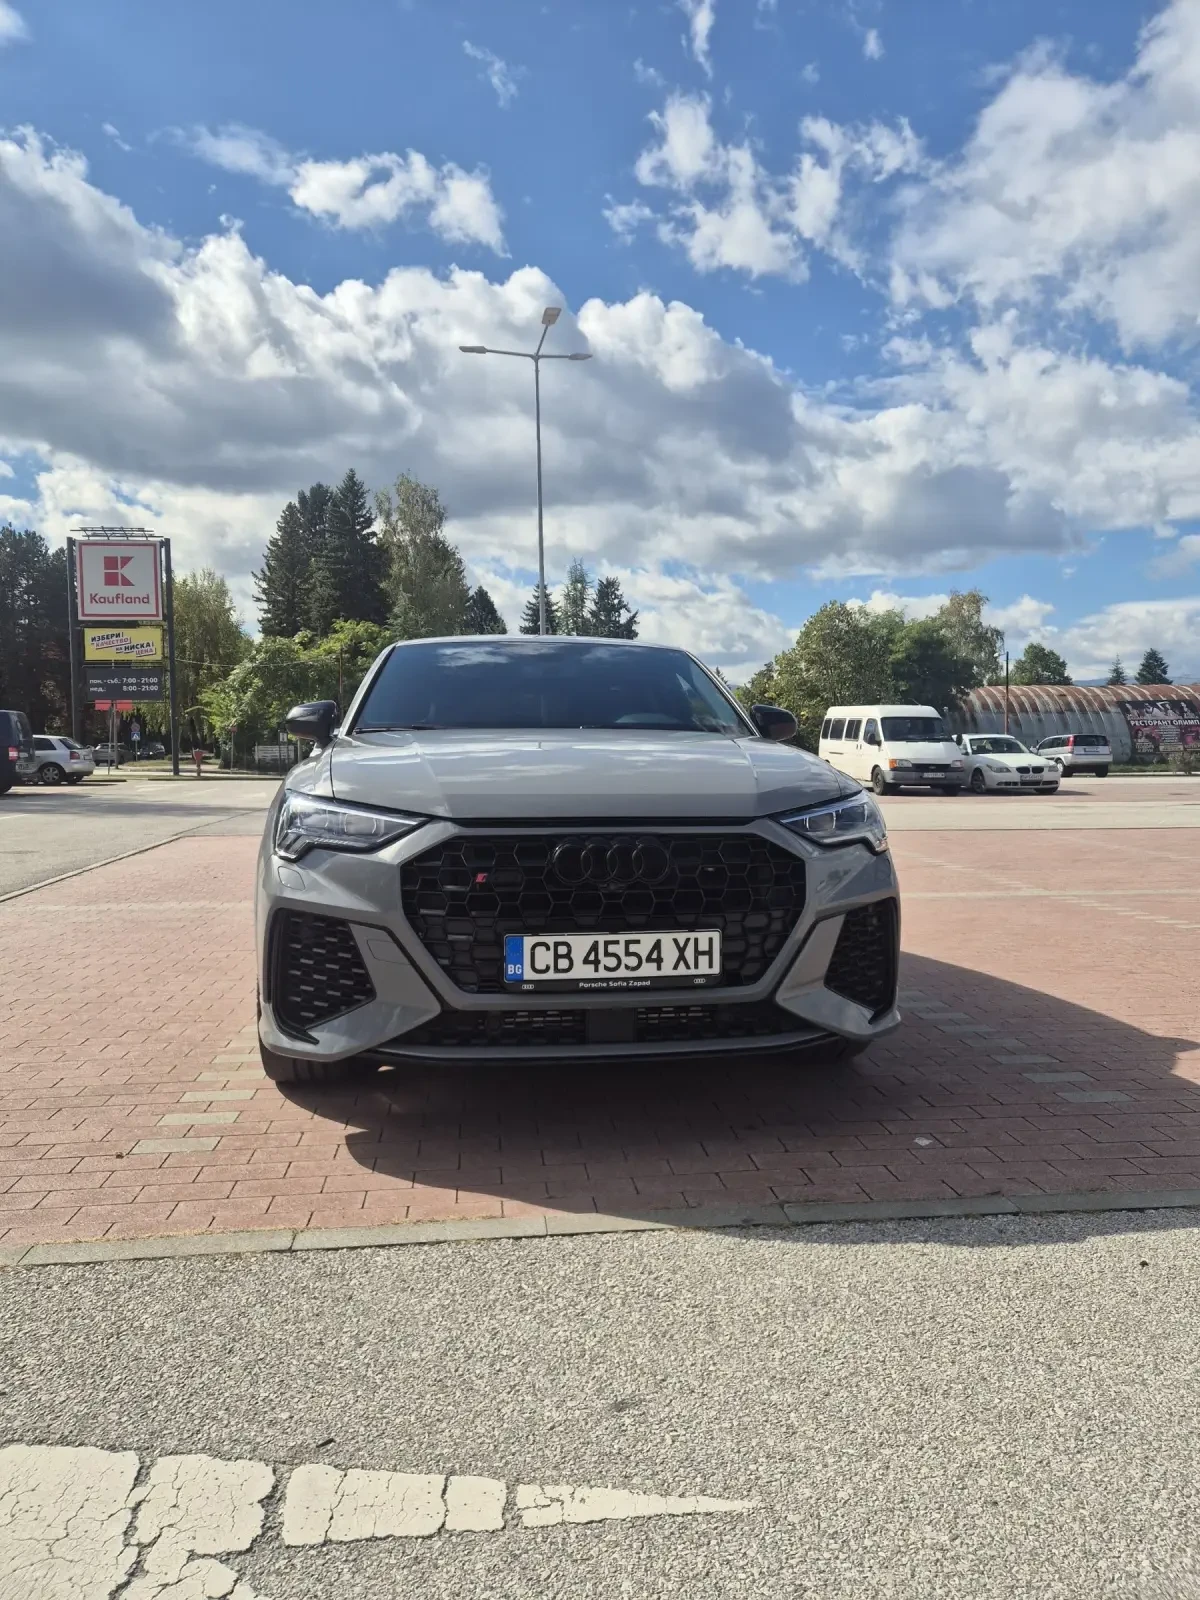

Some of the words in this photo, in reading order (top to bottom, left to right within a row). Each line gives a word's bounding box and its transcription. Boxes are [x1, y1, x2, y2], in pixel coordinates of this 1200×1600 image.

[90, 593, 150, 604] Kaufland
[95, 637, 129, 648] КАЧЕСТВО
[530, 940, 574, 974] CB
[582, 938, 664, 973] 4554
[672, 937, 714, 971] XH
[507, 964, 522, 974] BG
